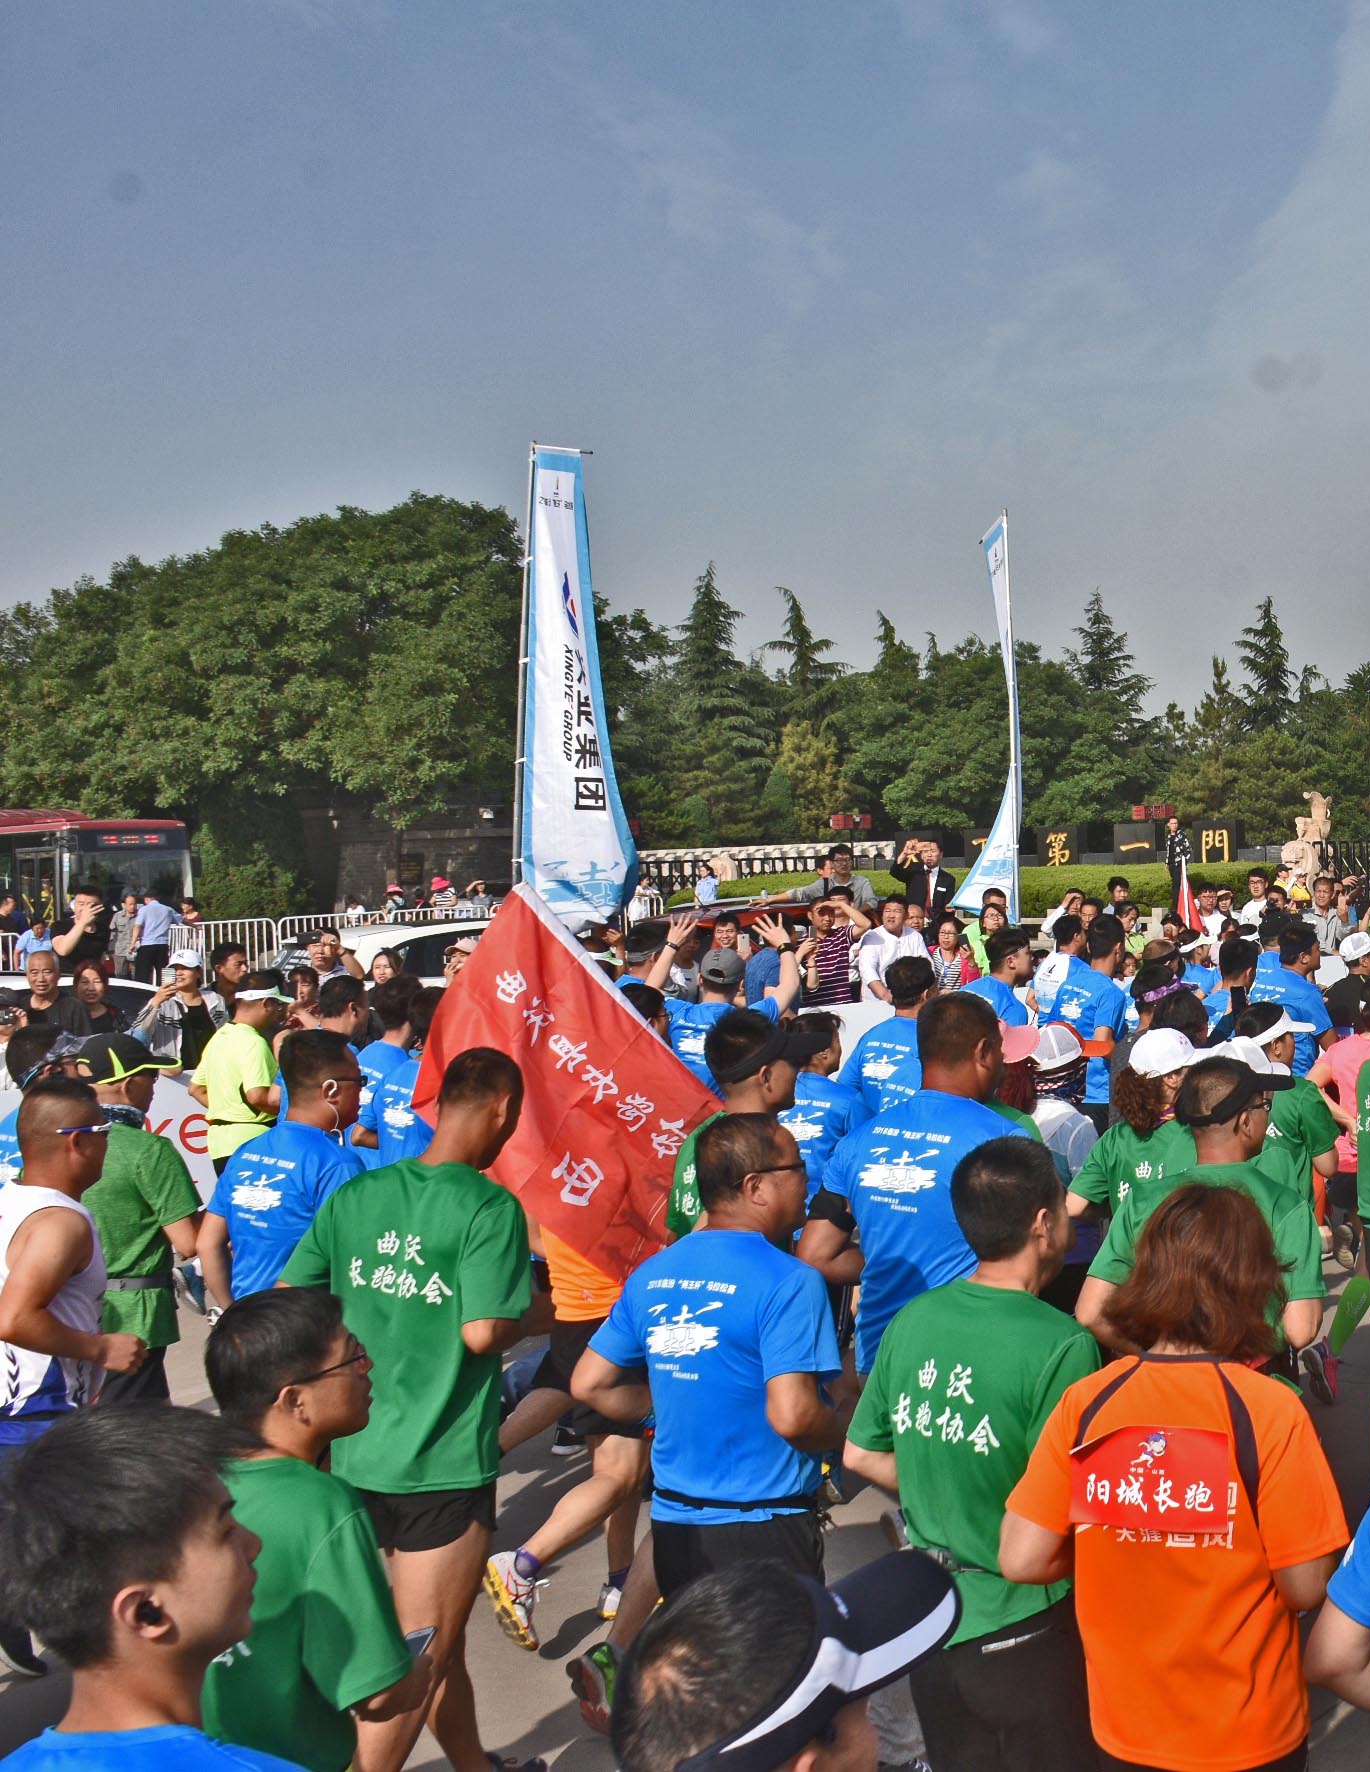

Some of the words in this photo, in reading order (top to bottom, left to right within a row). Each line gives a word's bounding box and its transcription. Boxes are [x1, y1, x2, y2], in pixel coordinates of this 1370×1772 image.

[563, 643, 574, 704] XINGYE
[562, 708, 573, 762] GROUP
[376, 1229, 426, 1266] 曲沃
[348, 1255, 454, 1306] 长跑协会
[918, 1357, 975, 1405] 曲沃
[890, 1392, 1001, 1457] 长跑协会
[1085, 1472, 1215, 1514] 阳城长跑
